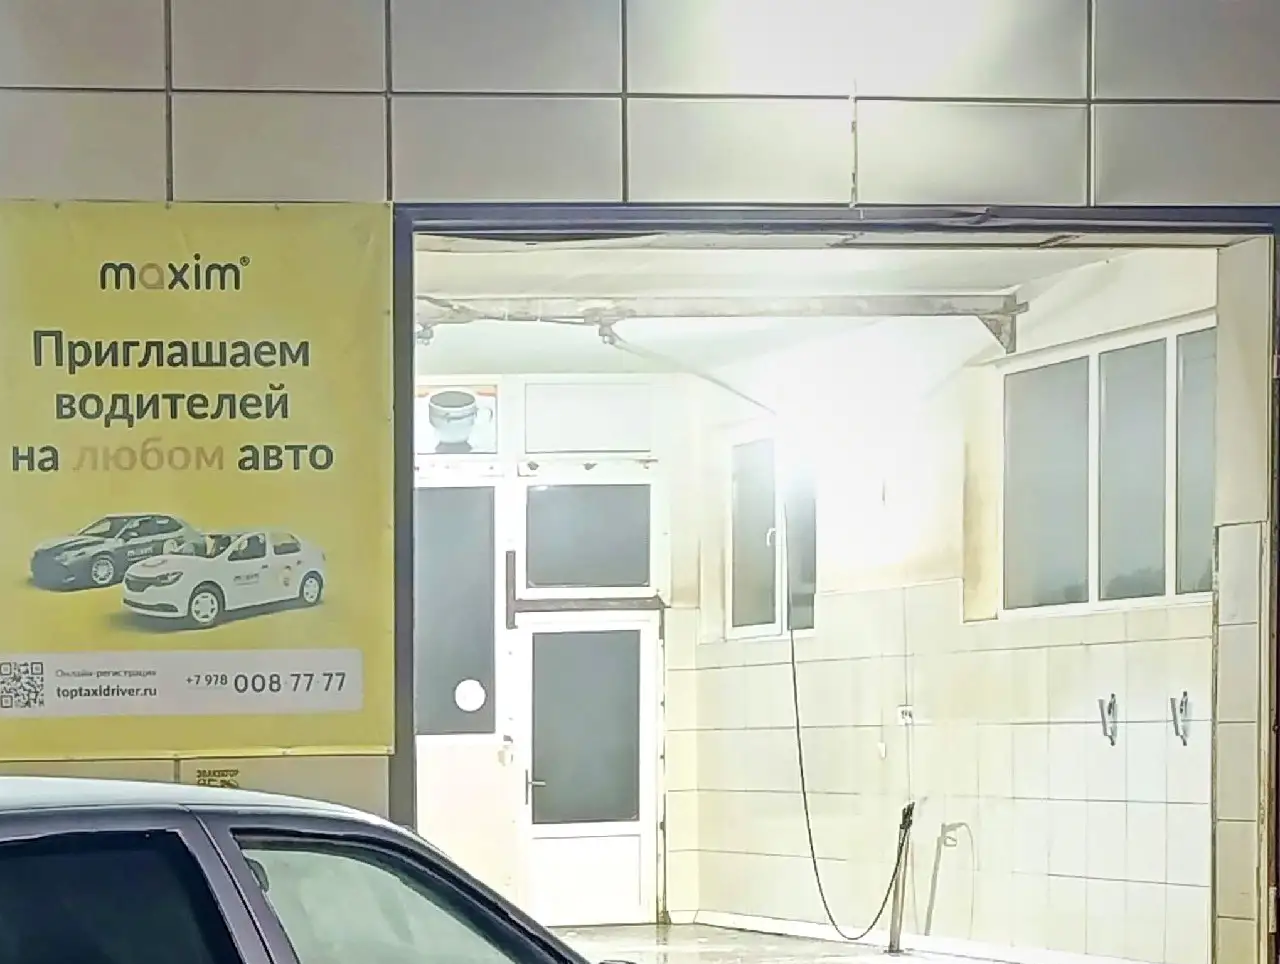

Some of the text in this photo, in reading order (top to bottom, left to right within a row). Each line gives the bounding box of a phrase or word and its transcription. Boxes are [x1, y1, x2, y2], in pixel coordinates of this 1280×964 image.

[100, 253, 242, 290] maxim
[33, 330, 310, 374] Приглашаем
[55, 383, 289, 428] водителей
[12, 438, 334, 472] на любом авто
[56, 685, 157, 699] toptaxidriver.ru
[204, 674, 228, 686] 978
[234, 673, 281, 693] 008
[290, 673, 314, 692] 77
[322, 672, 346, 691] 77
